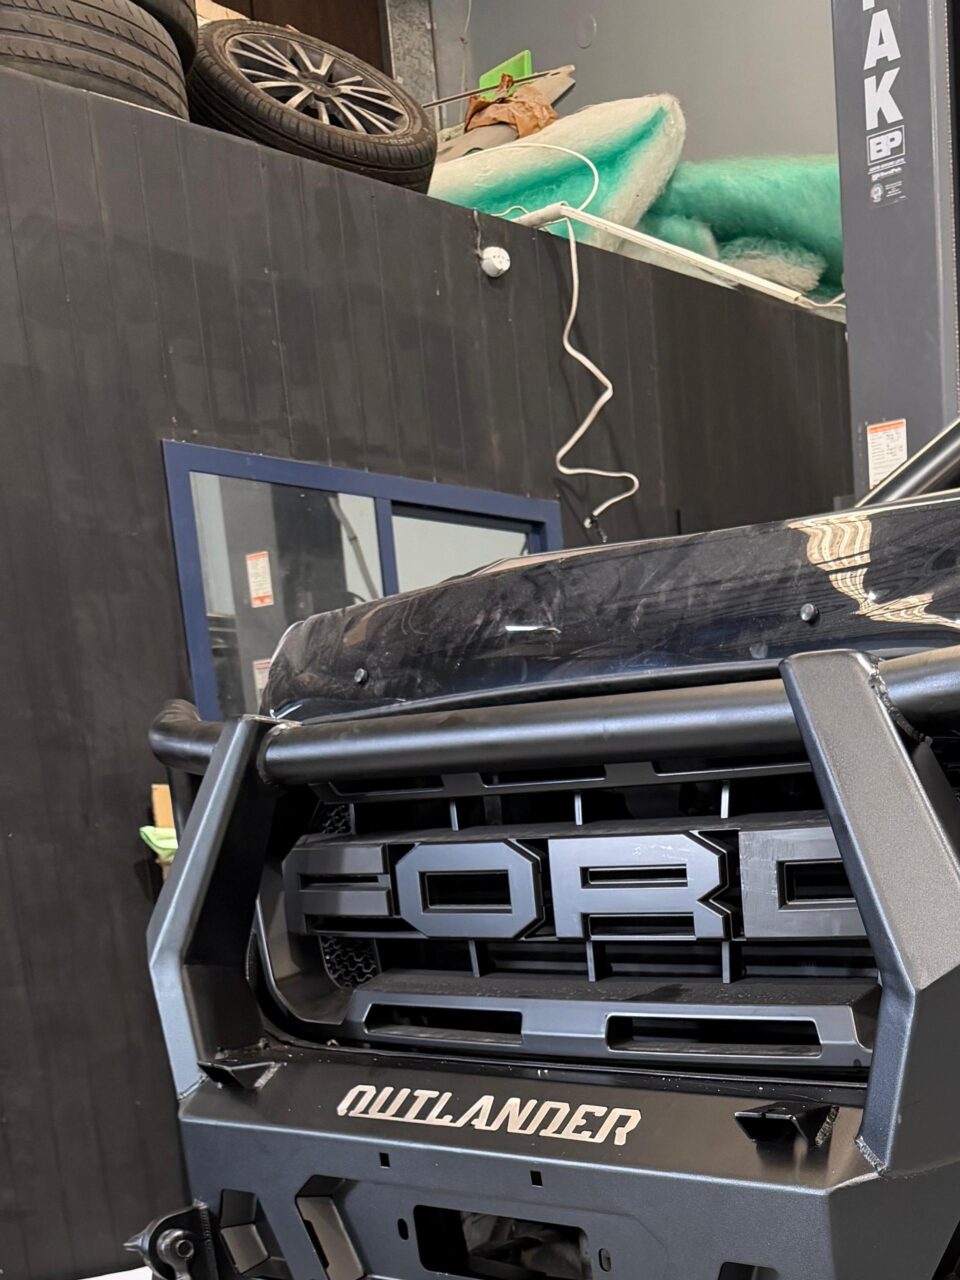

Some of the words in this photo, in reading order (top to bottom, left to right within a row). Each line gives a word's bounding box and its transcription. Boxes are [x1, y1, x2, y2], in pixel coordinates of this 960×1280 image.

[862, 0, 904, 130] AK
[869, 130, 903, 161] BP
[336, 1084, 642, 1145] OUTLANDER
